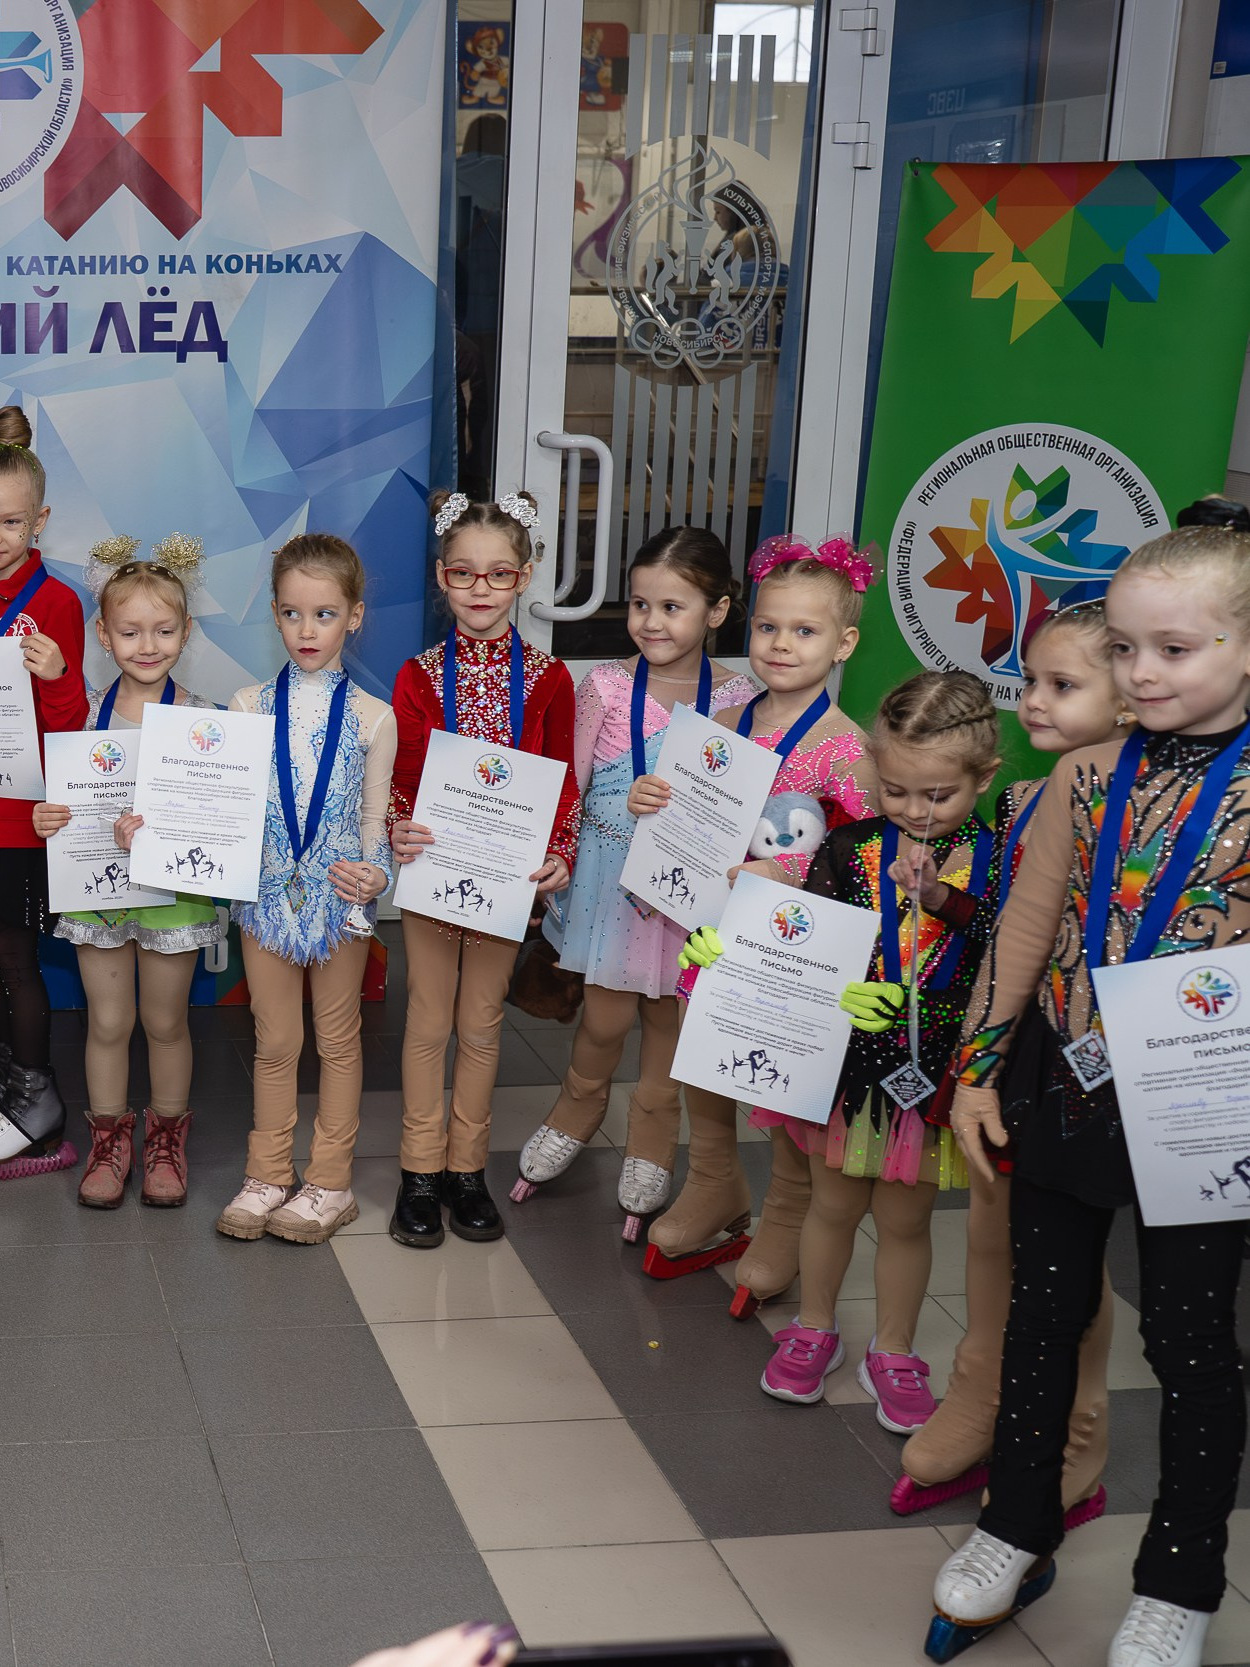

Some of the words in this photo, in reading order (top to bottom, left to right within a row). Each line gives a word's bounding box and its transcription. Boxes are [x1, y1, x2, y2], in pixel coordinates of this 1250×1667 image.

[50, 78, 73, 132] ОБЛАСТИ»
[724, 187, 764, 230] КУЛЬТУРЫ
[760, 230, 768, 239] И
[6, 254, 150, 276] КАТАНИЮ
[158, 254, 197, 275] НА
[205, 253, 343, 275] КОНЬКАХ
[762, 241, 772, 283] СПОРТА
[88, 286, 228, 363] ЛЁД
[917, 439, 996, 506] РЕГИОНАЛЬНАЯ
[997, 432, 1097, 461] ОБЩЕСТВЕННАЯ
[1095, 451, 1159, 529] ОРГАНИЗАЦИЯ
[896, 520, 917, 602] «ФЕДЕРАЦИЯ
[903, 602, 947, 667] ФИГУРНОГО
[996, 685, 1011, 701] НА
[162, 755, 250, 772] Благодарственное
[186, 770, 222, 780] письмо
[67, 780, 136, 791] Благодарствен
[93, 790, 128, 800] письмо
[674, 762, 744, 808] Благодарственное
[690, 784, 719, 806] письмо
[444, 782, 534, 814] Благодарственное
[468, 800, 504, 817] письмо
[734, 934, 839, 974] Благодарственное
[760, 958, 803, 978] письмо
[812, 991, 839, 1004] фигурног
